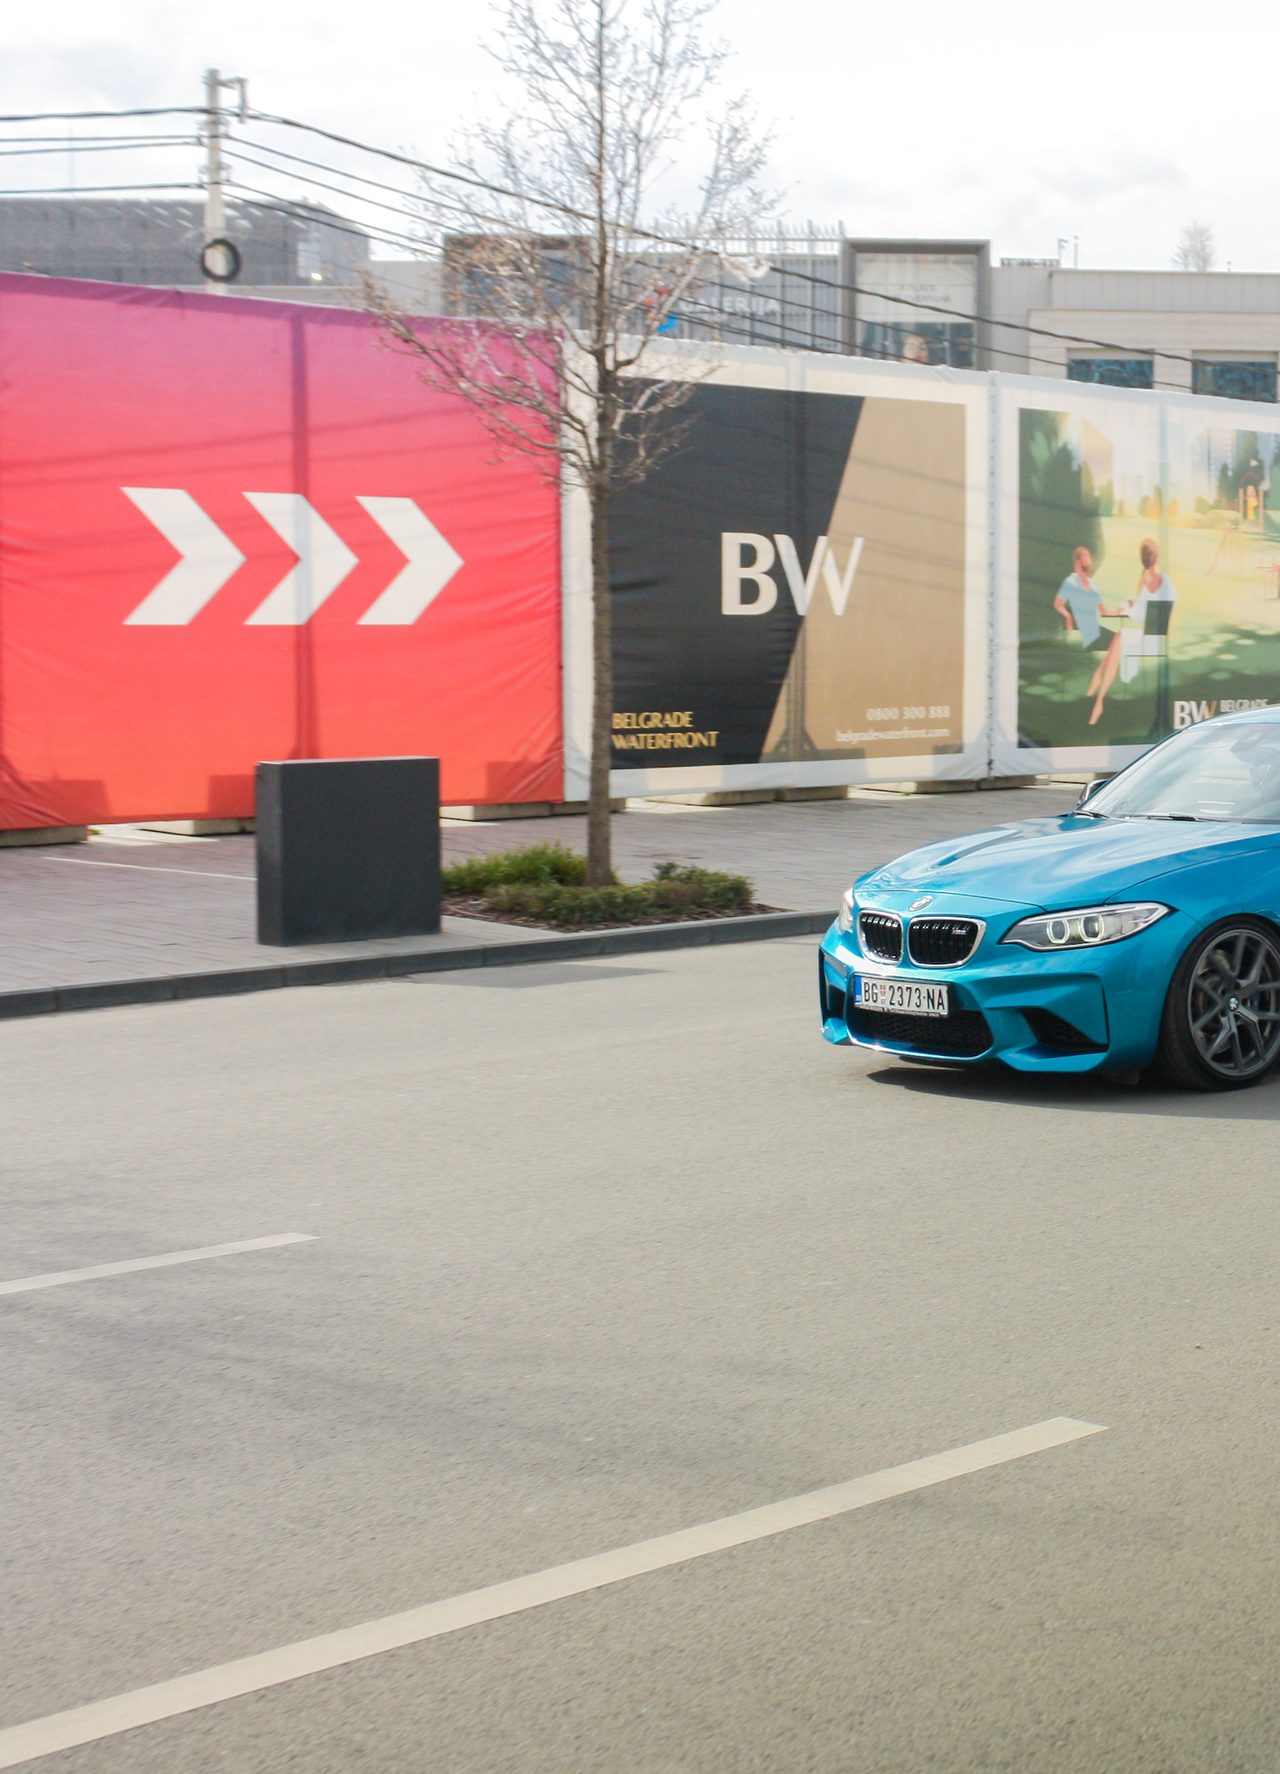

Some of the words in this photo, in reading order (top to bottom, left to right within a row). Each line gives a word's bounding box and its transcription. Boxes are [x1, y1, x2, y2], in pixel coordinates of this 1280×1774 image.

[721, 532, 865, 616] BW
[612, 711, 694, 729] BELGRADE
[1173, 700, 1218, 730] BW
[611, 731, 719, 750] WATERFRONT
[863, 982, 878, 1003] BG
